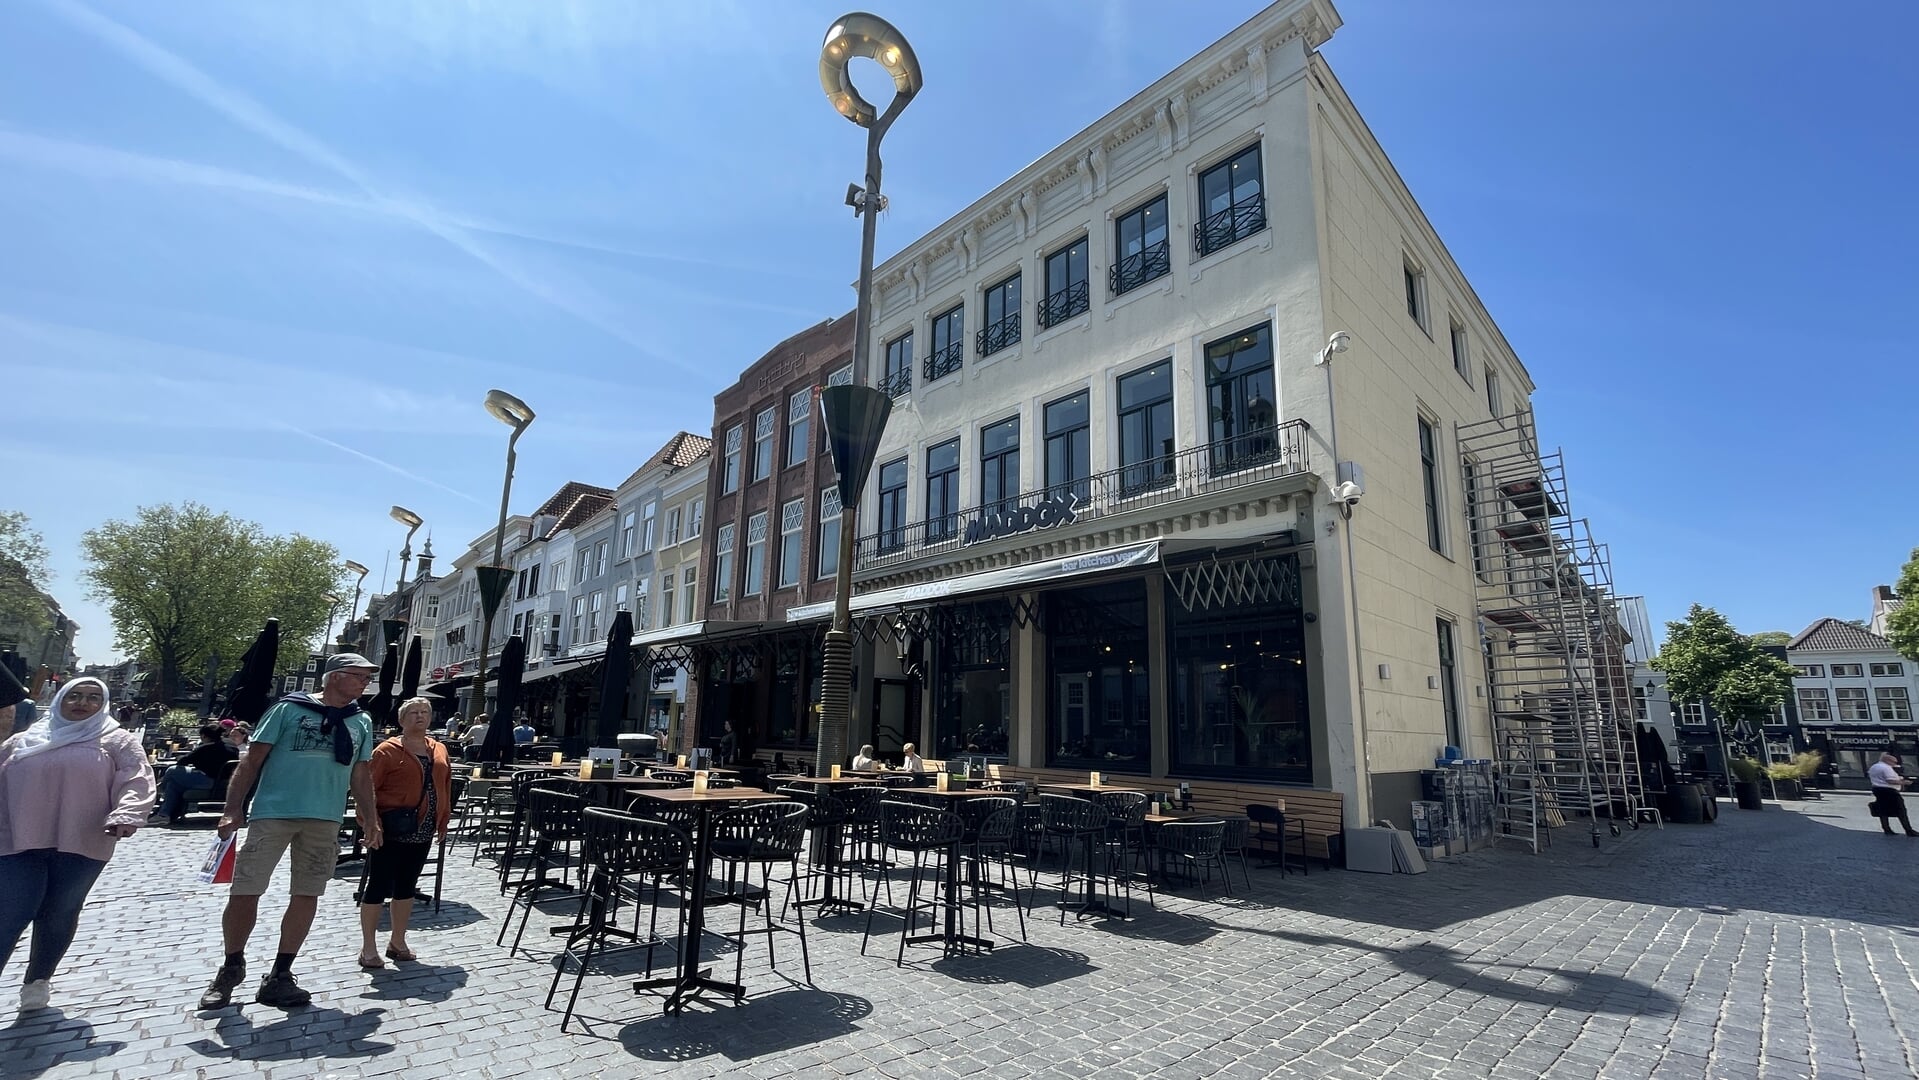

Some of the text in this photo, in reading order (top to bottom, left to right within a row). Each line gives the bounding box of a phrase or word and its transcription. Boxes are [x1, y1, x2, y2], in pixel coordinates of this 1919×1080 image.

[963, 493, 1078, 547] MADDOX
[1062, 560, 1078, 572] bar
[1079, 555, 1115, 568] kitchen
[903, 581, 951, 600] MADDOX
[1832, 737, 1890, 745] TOROMANO
